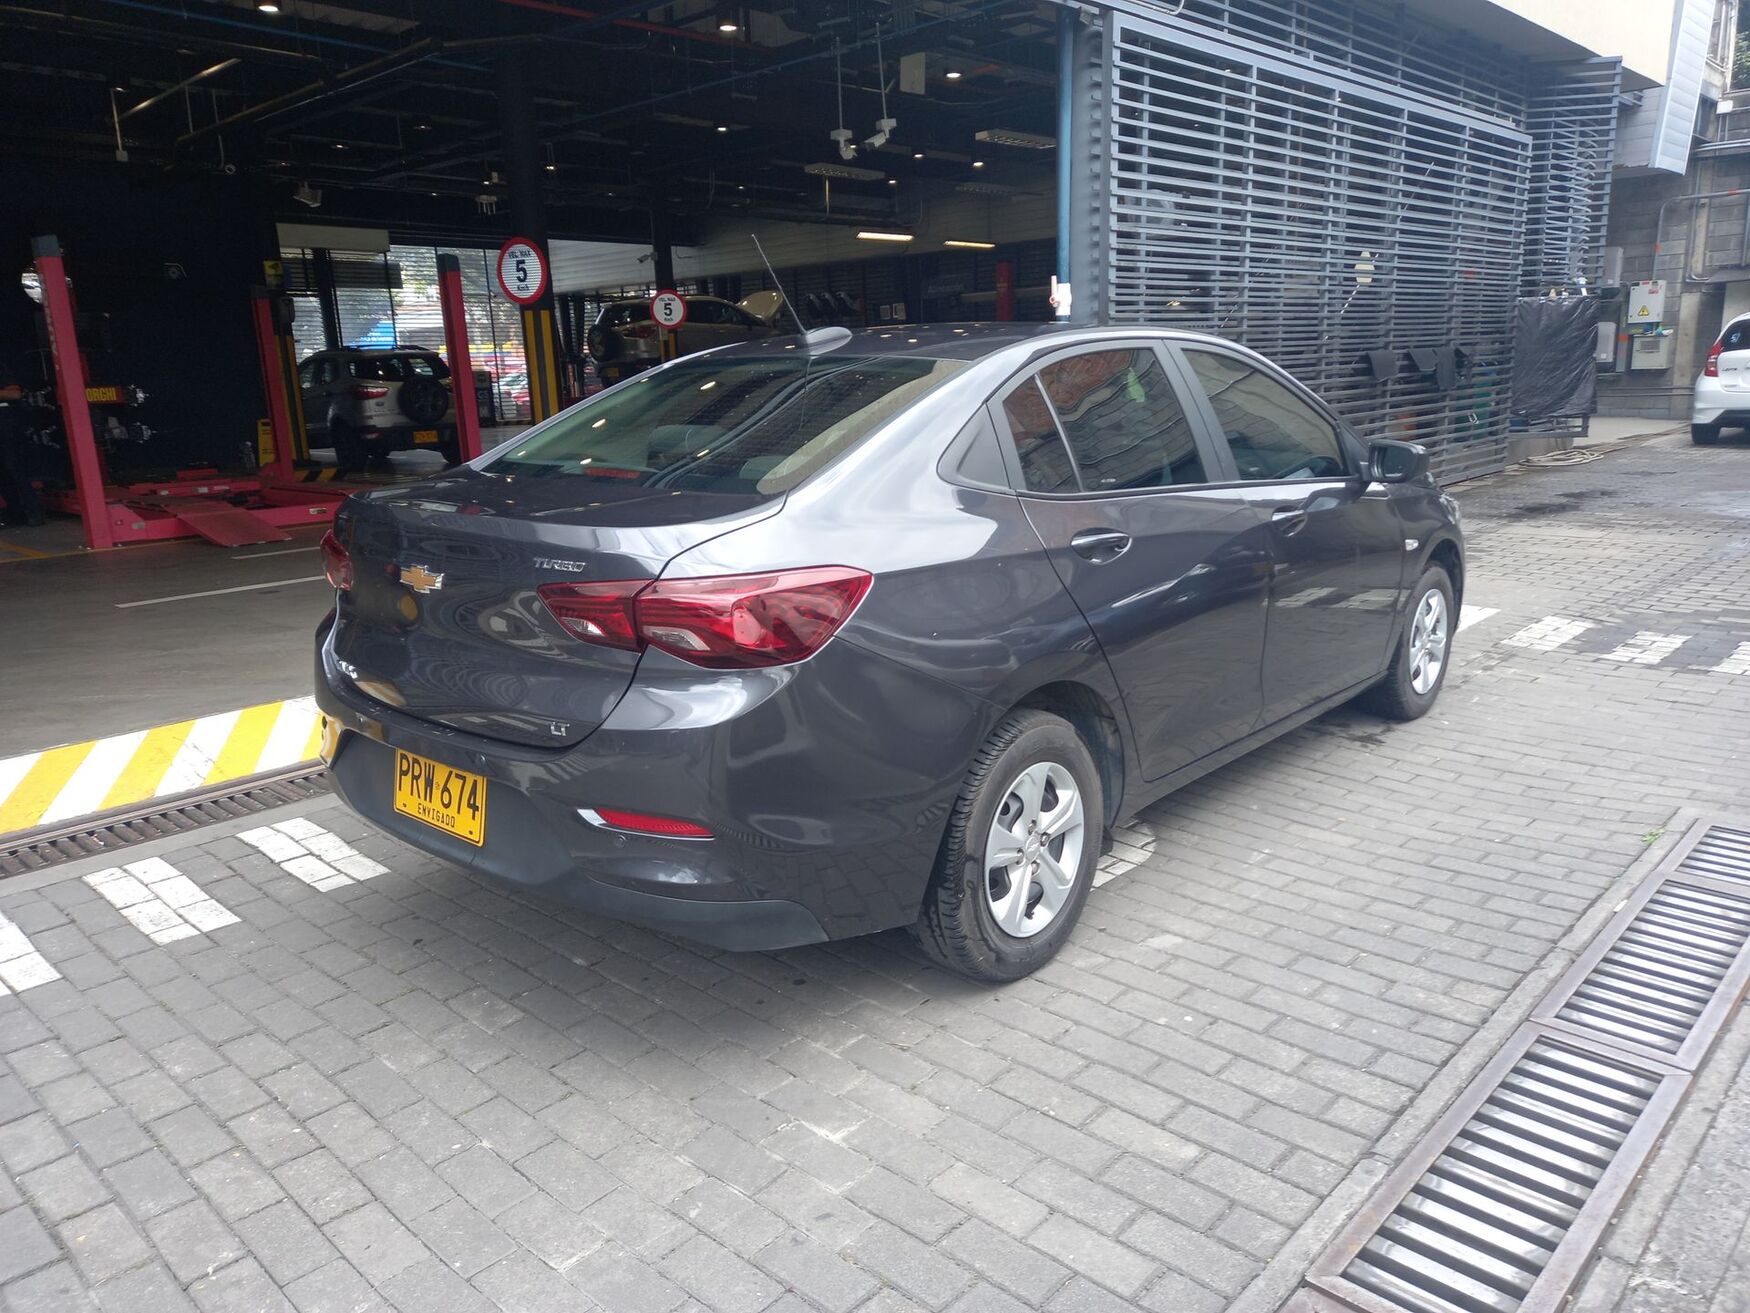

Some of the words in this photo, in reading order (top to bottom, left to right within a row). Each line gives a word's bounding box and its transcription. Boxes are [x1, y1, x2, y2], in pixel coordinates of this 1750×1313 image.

[516, 259, 527, 283] 5
[664, 302, 672, 316] 5
[533, 557, 586, 573] TURBO
[550, 721, 570, 737] LT
[399, 752, 435, 804] PRW
[440, 770, 480, 821] 674
[417, 803, 456, 828] ENVIGADO
